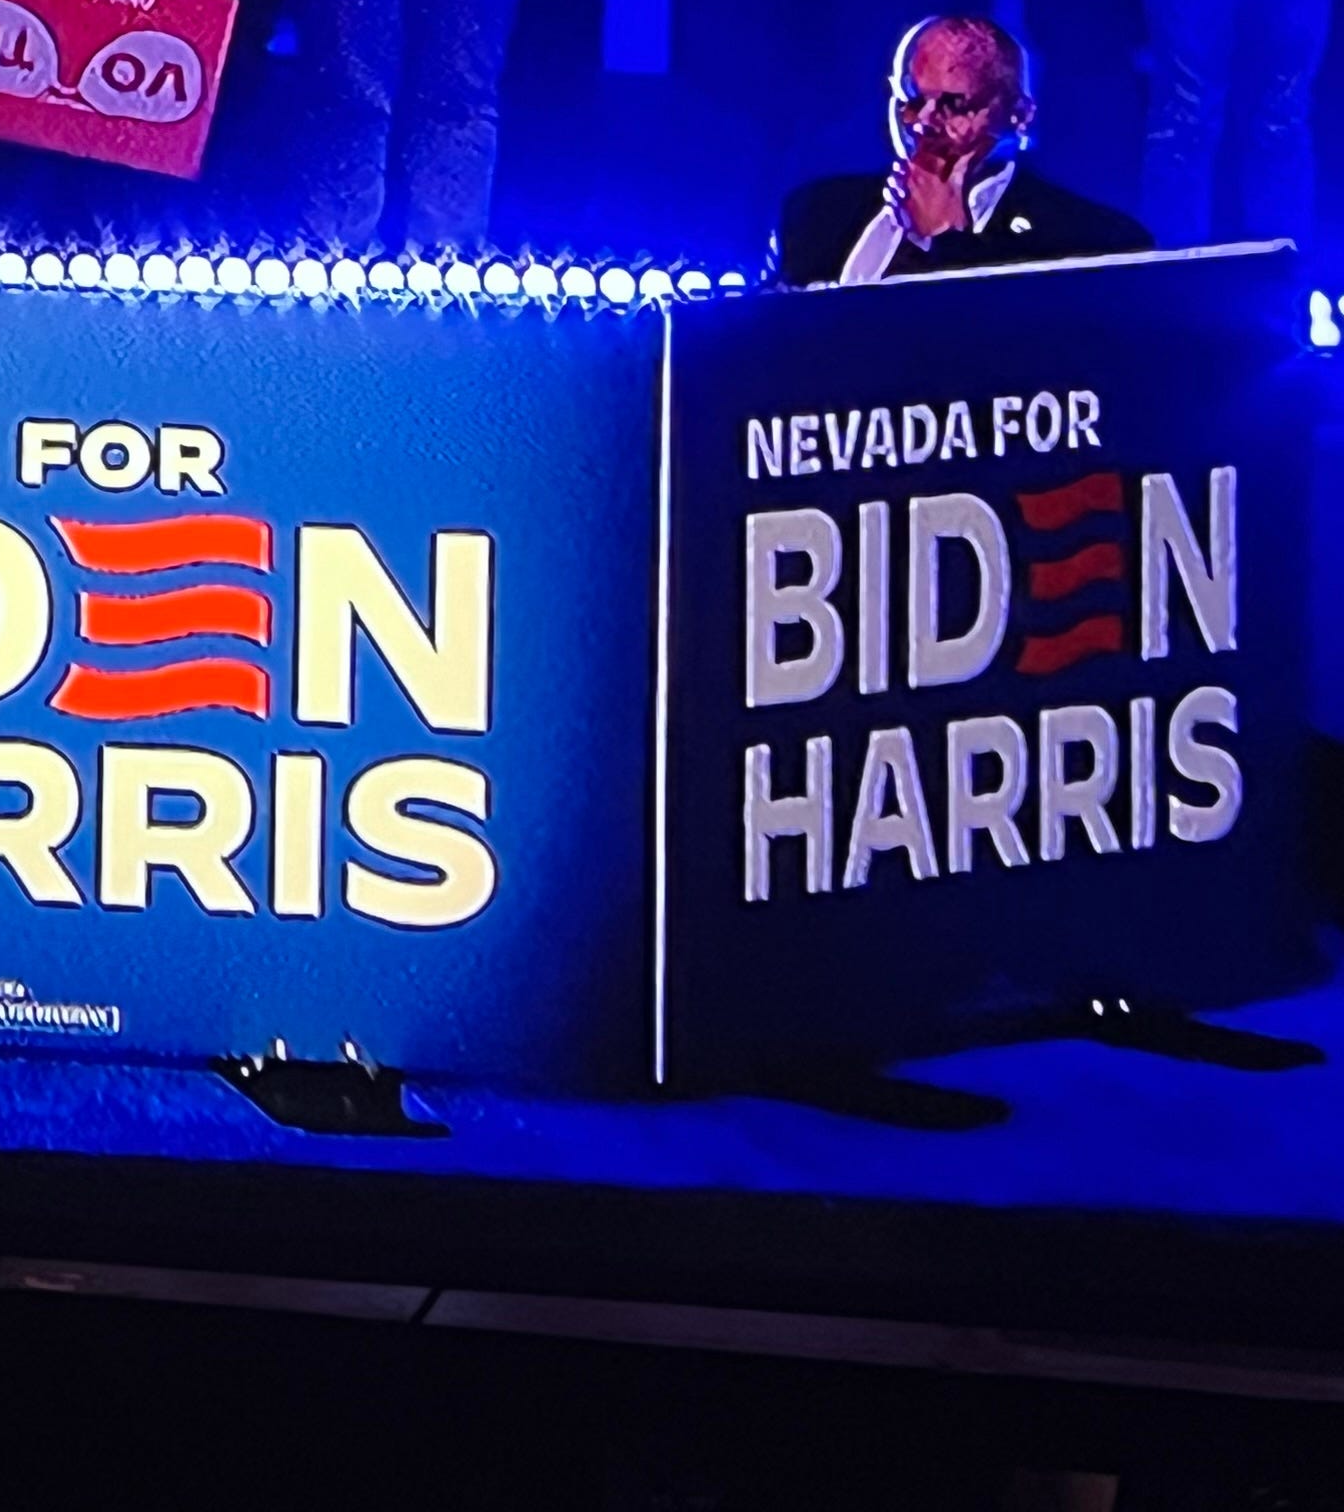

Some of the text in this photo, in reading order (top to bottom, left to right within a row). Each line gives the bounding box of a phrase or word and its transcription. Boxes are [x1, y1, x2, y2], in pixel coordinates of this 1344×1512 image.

[17, 419, 224, 494] FOR
[746, 389, 1102, 481] NEVADA FOR
[745, 465, 1239, 708] BIDEN
[743, 687, 1245, 903] HARRIS
